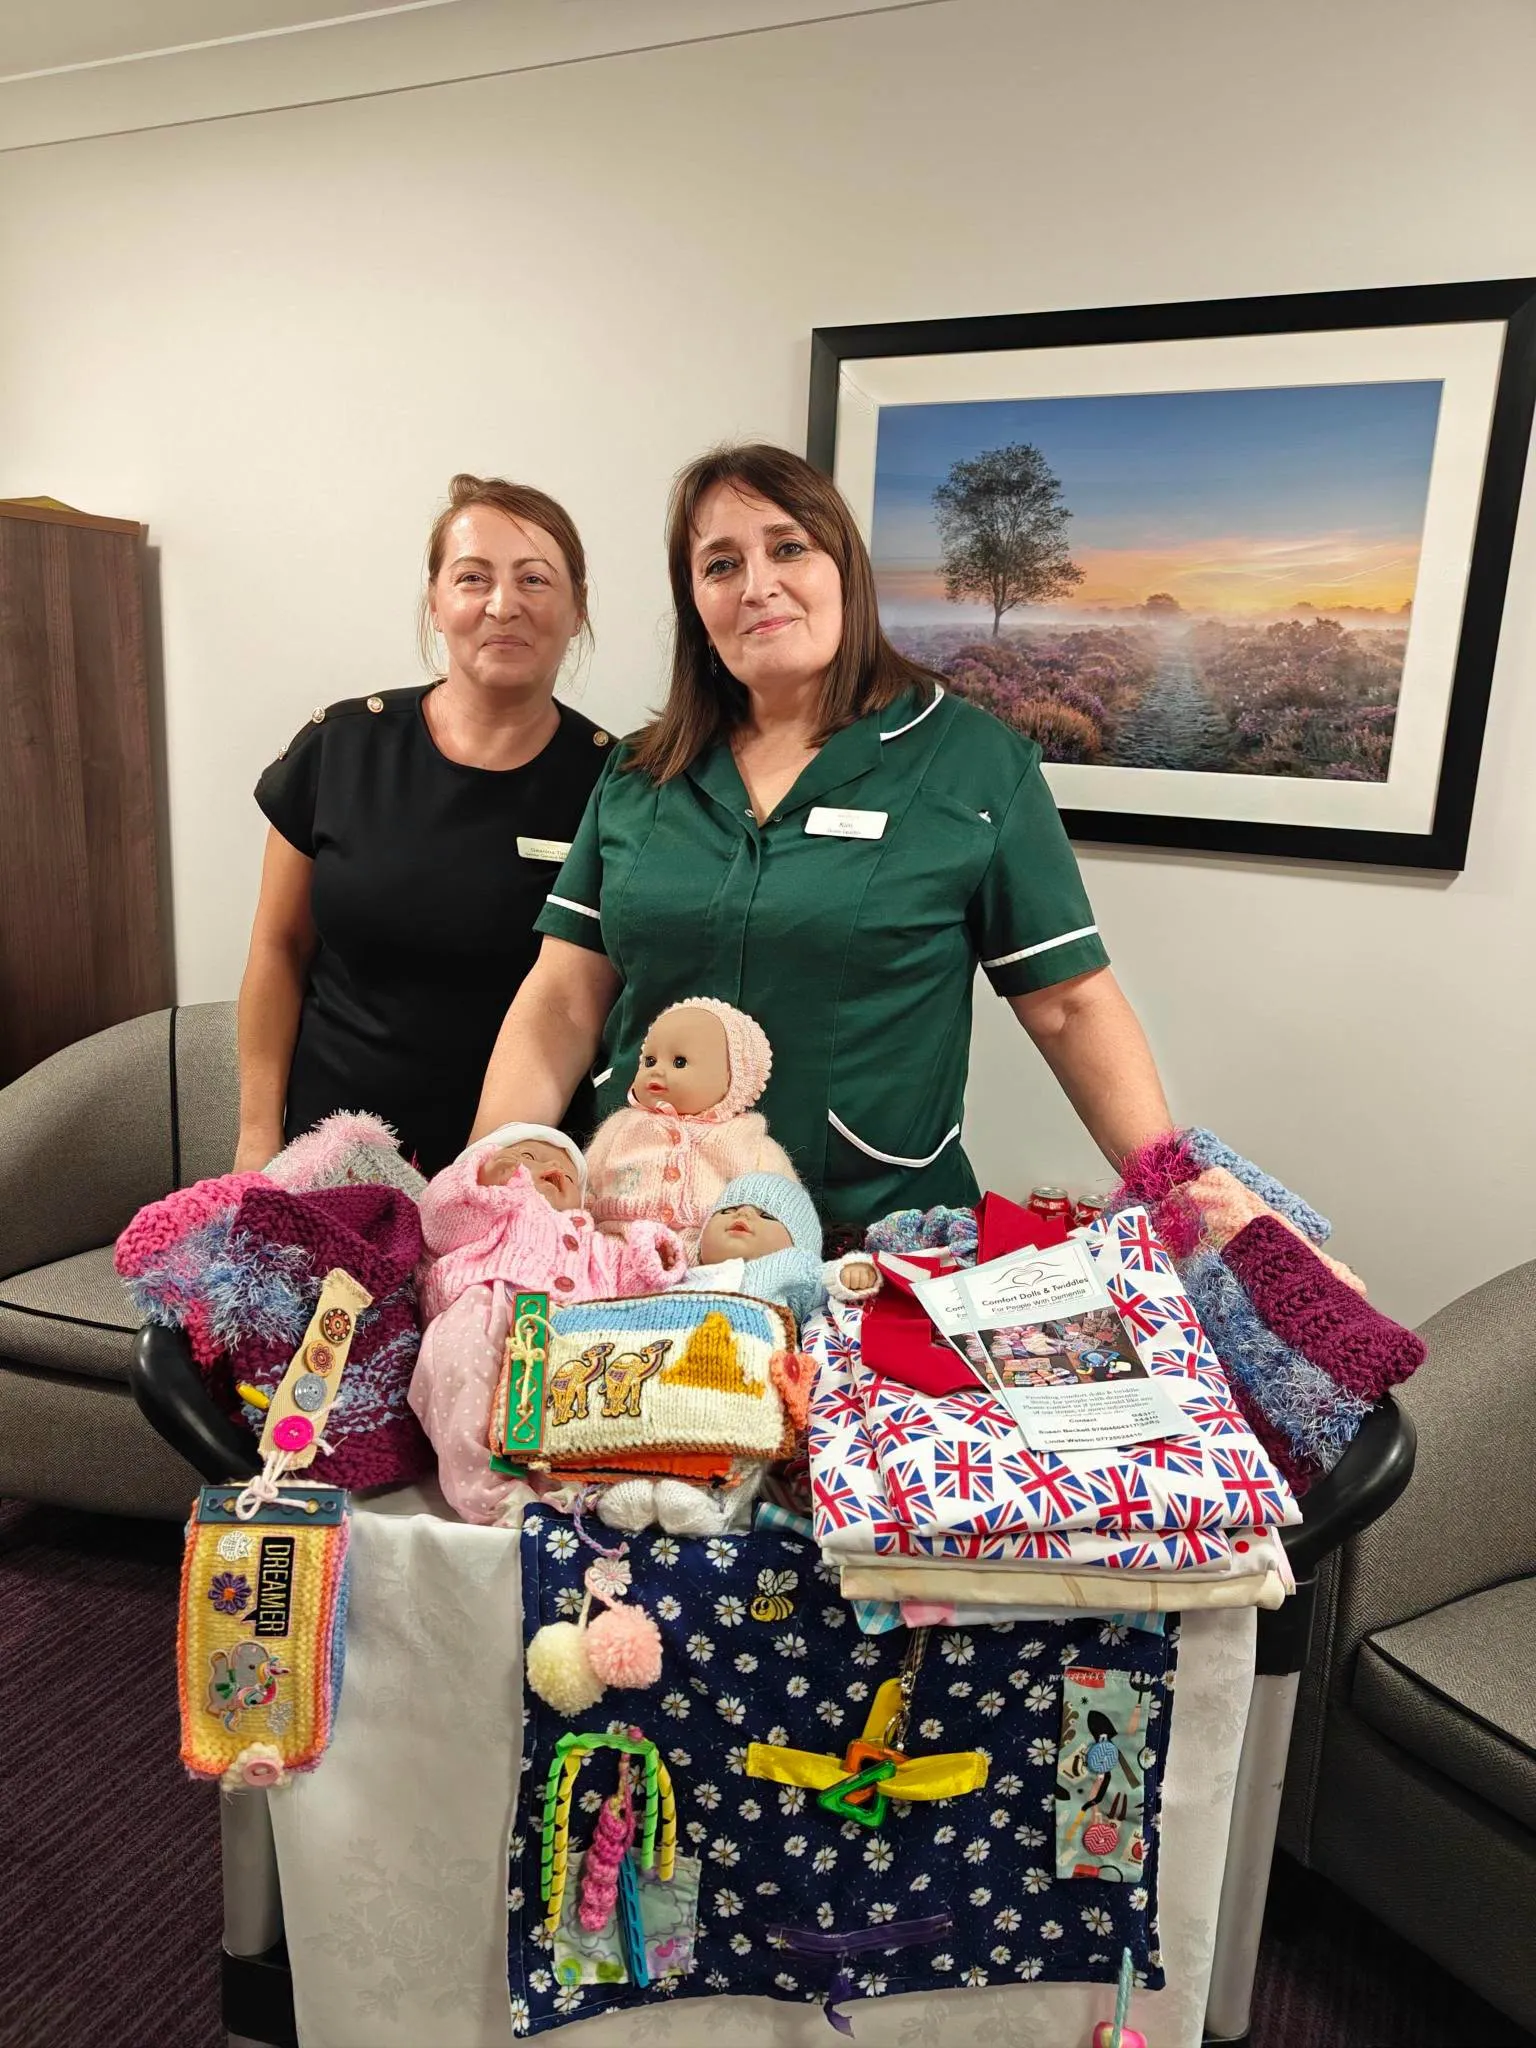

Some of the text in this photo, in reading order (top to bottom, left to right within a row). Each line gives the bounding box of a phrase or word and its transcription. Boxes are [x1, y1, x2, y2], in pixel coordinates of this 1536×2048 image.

[981, 1295, 1018, 1307] Comfort
[1019, 1290, 1041, 1300] Dolls
[1052, 1278, 1089, 1291] Twiddles
[1006, 1302, 1032, 1311] People
[1032, 1298, 1050, 1306] With
[1050, 1288, 1086, 1301] Dementia
[258, 1544, 291, 1631] DREAMER
